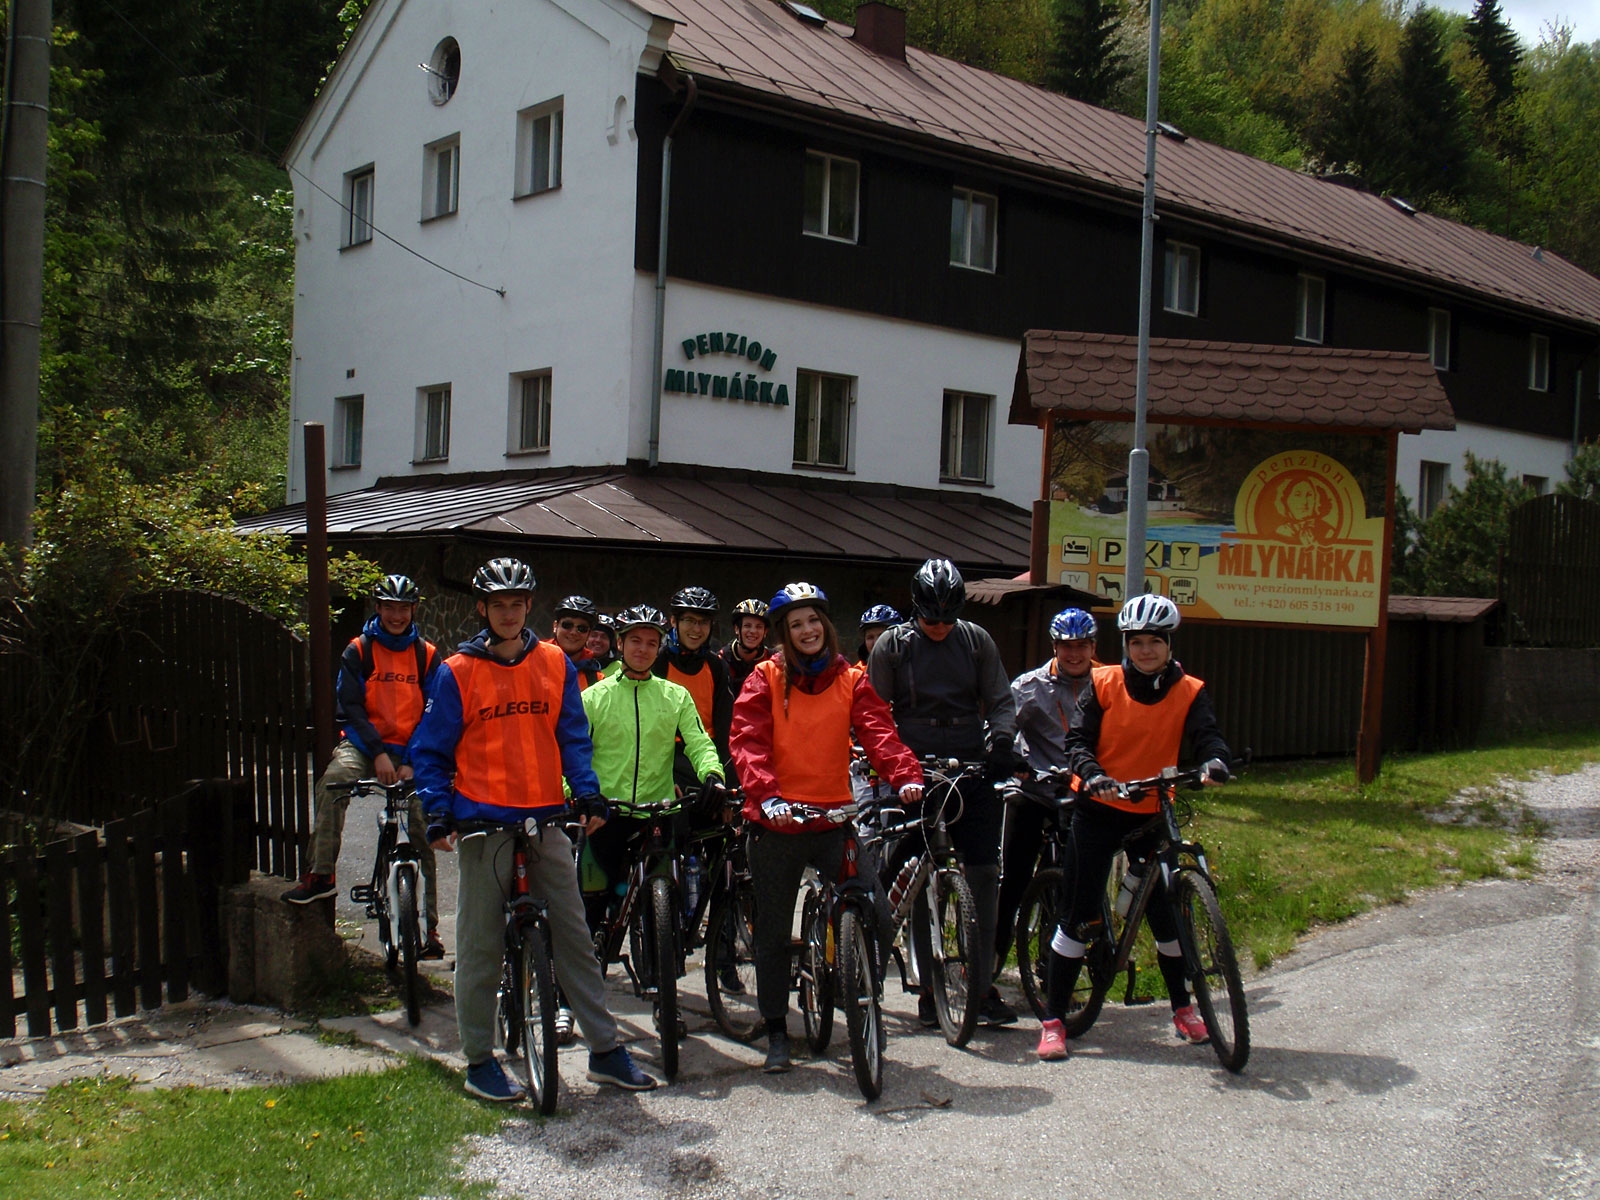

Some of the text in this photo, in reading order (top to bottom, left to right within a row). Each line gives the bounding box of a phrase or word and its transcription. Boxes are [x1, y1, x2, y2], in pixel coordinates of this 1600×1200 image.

[682, 332, 777, 371] PENZION
[664, 369, 789, 406] MLYNÁŘKA
[1257, 454, 1345, 485] penzion
[1105, 541, 1122, 562] P
[1218, 543, 1375, 583] MLYNÁŘKA
[1068, 574, 1081, 584] TV
[1260, 599, 1286, 609] +420
[1289, 600, 1309, 610] 605
[1311, 601, 1331, 611] 518
[1335, 602, 1355, 613] 190
[377, 672, 418, 684] LEGE
